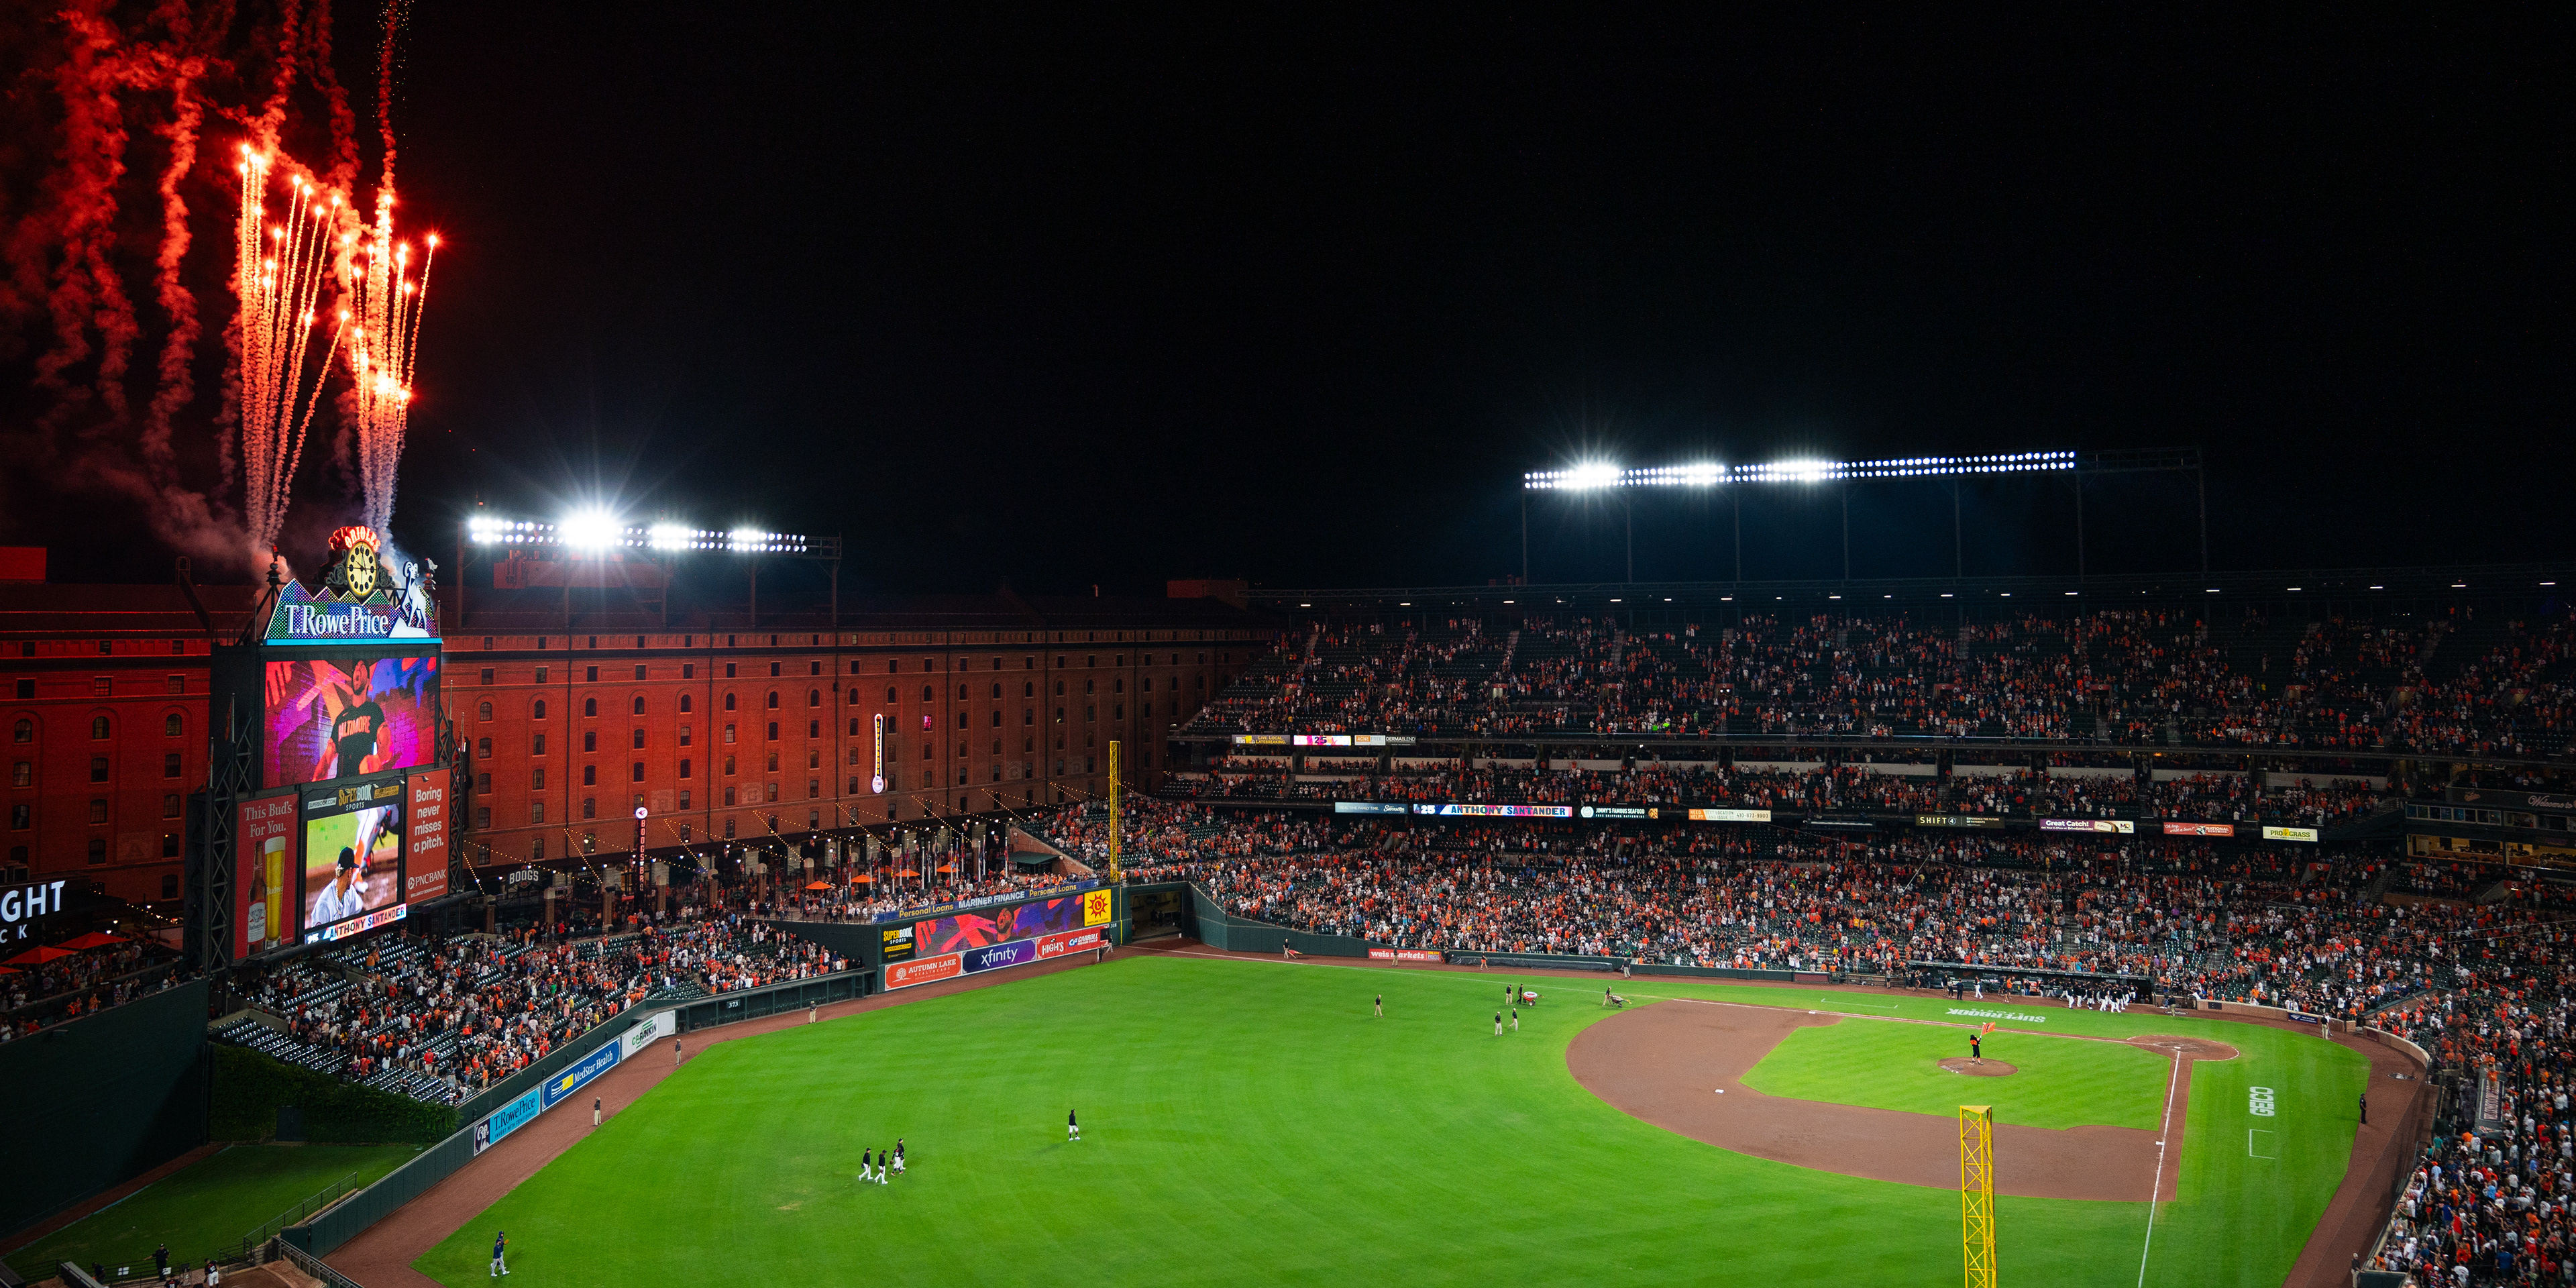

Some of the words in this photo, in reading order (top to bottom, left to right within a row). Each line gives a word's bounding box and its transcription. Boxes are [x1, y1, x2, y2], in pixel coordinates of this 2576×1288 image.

[344, 525, 381, 551] ORIOLES
[415, 786, 442, 802] Boring
[2528, 795, 2565, 808] Welcome
[244, 805, 266, 821] This
[268, 800, 292, 817] Bud's
[309, 798, 335, 808] SUPERBOOK.COM
[345, 802, 365, 811] SPORTS
[1421, 805, 1436, 814] 25
[1451, 806, 1503, 814] ANTHONY
[1507, 806, 1566, 816] SANTANDER
[417, 805, 440, 818] never
[415, 820, 442, 836] misses
[1919, 816, 1947, 824] SHIFT
[250, 823, 266, 838] For
[267, 820, 286, 834] You.
[413, 842, 420, 853] a
[421, 834, 444, 854] pitch.
[509, 869, 539, 885] BOOG'S
[899, 906, 931, 918] Personal
[932, 904, 954, 914] Loans
[958, 897, 993, 909] MARINER
[994, 891, 1025, 904] FINANCE
[1029, 887, 1058, 898] Personal
[1058, 883, 1077, 893] Loans
[329, 918, 366, 938] ANTHONY
[368, 906, 405, 926] SANTANDER
[883, 926, 913, 942] SUPERBOOK
[1077, 932, 1099, 942] CARROLL
[1042, 941, 1064, 955] HIGH'S
[981, 947, 1018, 967] xfinity
[908, 963, 938, 974] AUTUMN
[938, 959, 957, 968] LAKE
[914, 966, 951, 977] HEALTHCARE
[1945, 1008, 2046, 1023] SUPERBOOK
[574, 1063, 596, 1083] MedStar
[596, 1050, 613, 1070] Health
[2249, 1086, 2275, 1117] GEICO
[494, 1128, 506, 1139] INVEST
[516, 1110, 535, 1126] CONFIDENCE
